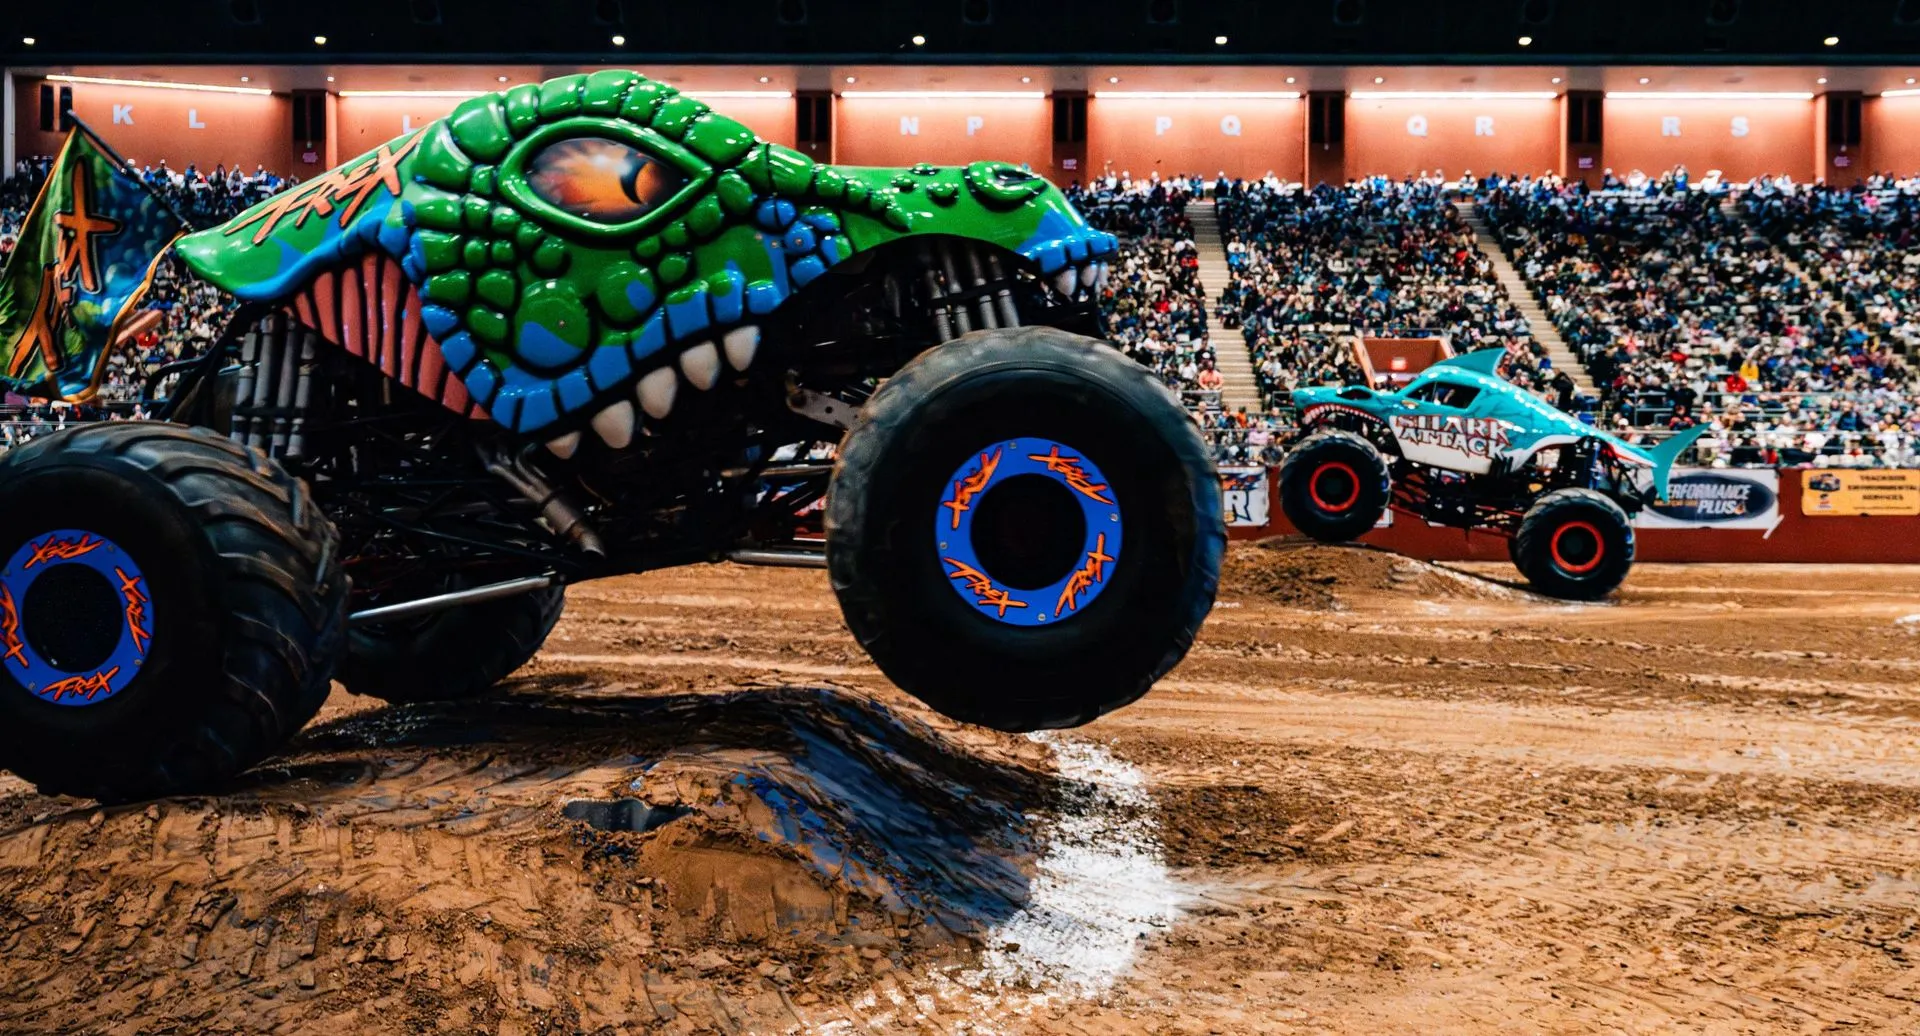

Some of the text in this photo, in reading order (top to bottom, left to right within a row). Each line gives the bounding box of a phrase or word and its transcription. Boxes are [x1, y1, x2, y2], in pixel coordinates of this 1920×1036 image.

[113, 104, 205, 128] K L
[900, 116, 983, 135] N P
[1155, 115, 1241, 136] P Q
[1407, 115, 1494, 136] Q R
[1662, 116, 1749, 136] R S
[1394, 414, 1512, 447] SHARK
[1399, 427, 1508, 459] ATTACK
[1657, 483, 1752, 500] ERFORMANCE
[1697, 500, 1737, 514] PLUS
